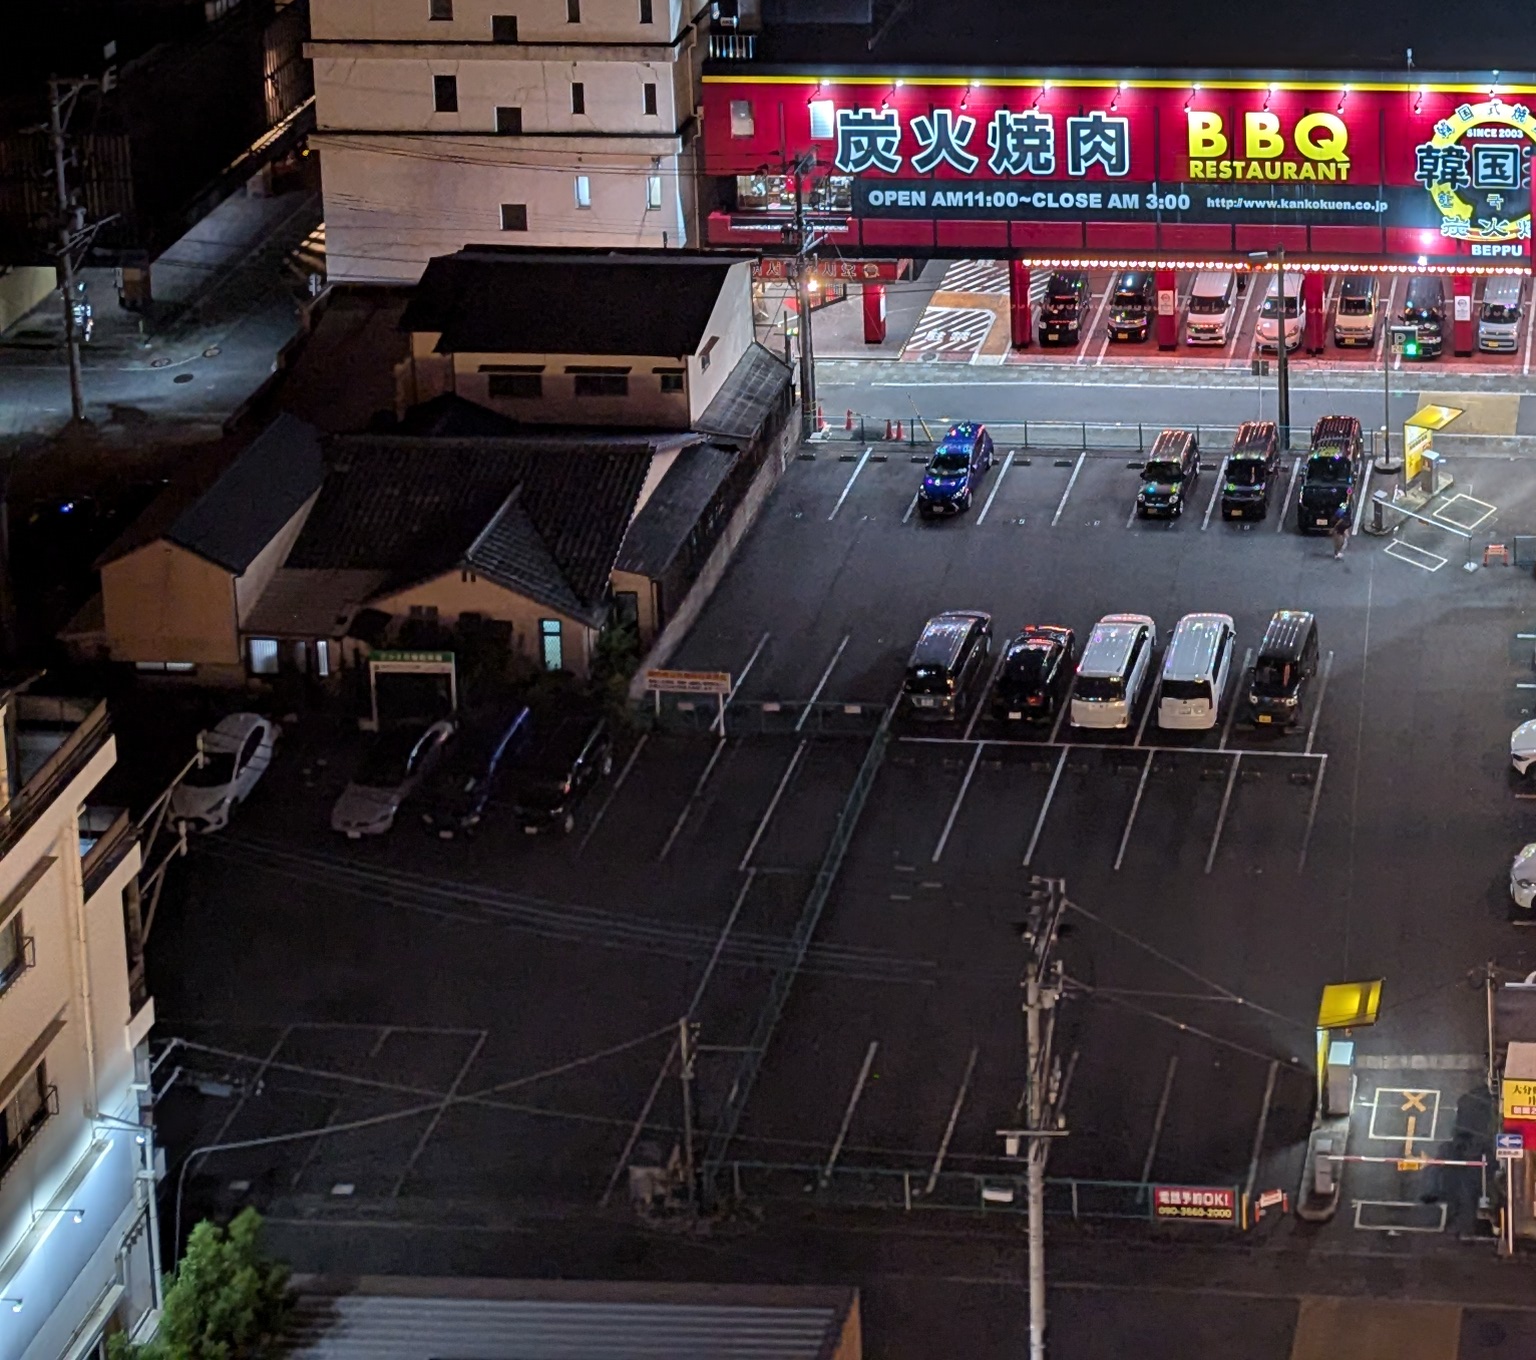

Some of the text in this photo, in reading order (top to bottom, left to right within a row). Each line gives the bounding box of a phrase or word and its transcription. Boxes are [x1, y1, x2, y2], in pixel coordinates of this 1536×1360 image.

[835, 109, 1130, 176] 炭火焼肉
[1466, 128, 1524, 139] SINCE 2003
[1189, 160, 1351, 181] RESTAURANT
[1415, 144, 1531, 191] 韓国
[868, 190, 926, 207] OPEN
[1107, 191, 1139, 209] AM
[1145, 193, 1190, 210] 3:00
[1206, 197, 1389, 213] http://www.kankokuen.co.jp
[1471, 244, 1523, 257] BEPPU
